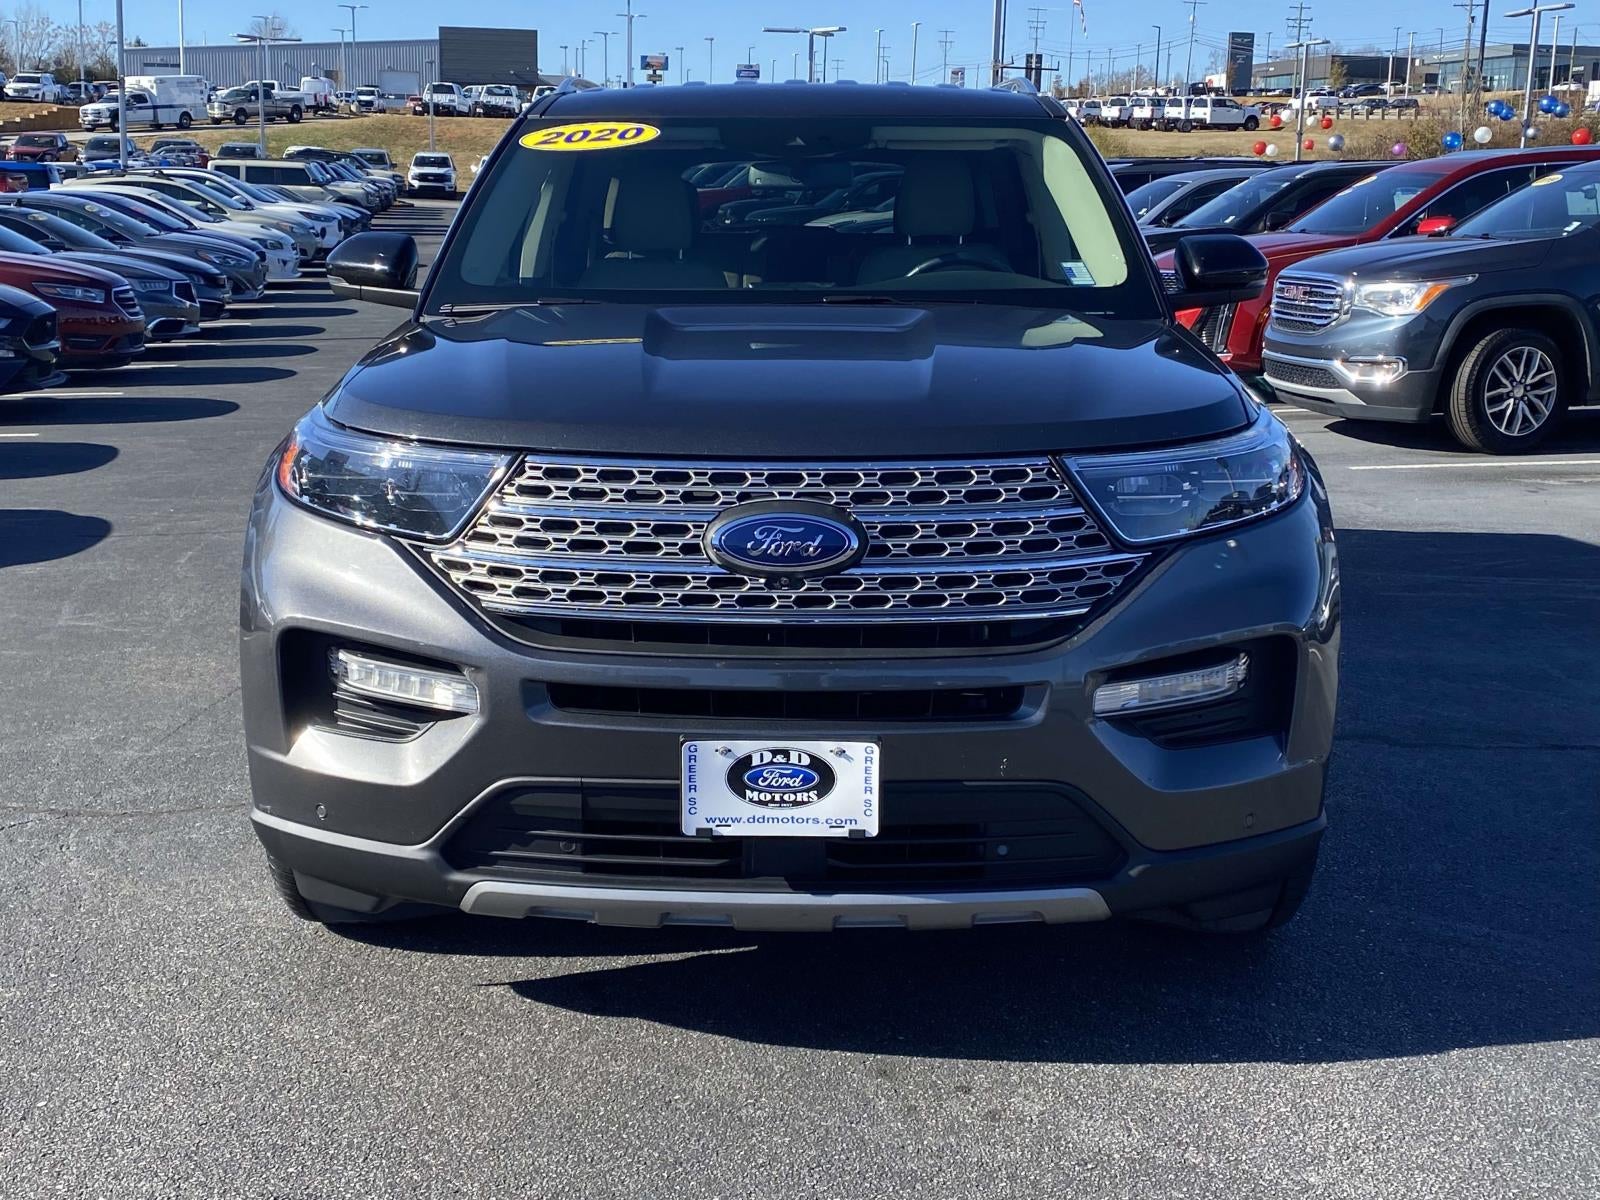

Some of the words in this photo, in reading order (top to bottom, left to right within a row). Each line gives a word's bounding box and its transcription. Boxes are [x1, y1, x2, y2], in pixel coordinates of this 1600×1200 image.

[534, 127, 645, 146] 2020
[1283, 285, 1311, 303] GMC
[746, 525, 824, 557] Ford
[751, 750, 811, 767] D&D
[688, 744, 698, 793] GREER
[757, 768, 804, 788] Ford
[864, 746, 874, 795] GREER
[745, 789, 819, 803] MOTORS
[688, 797, 698, 816] SC
[863, 799, 874, 818] SC
[704, 815, 858, 826] www.ddmotors.com
